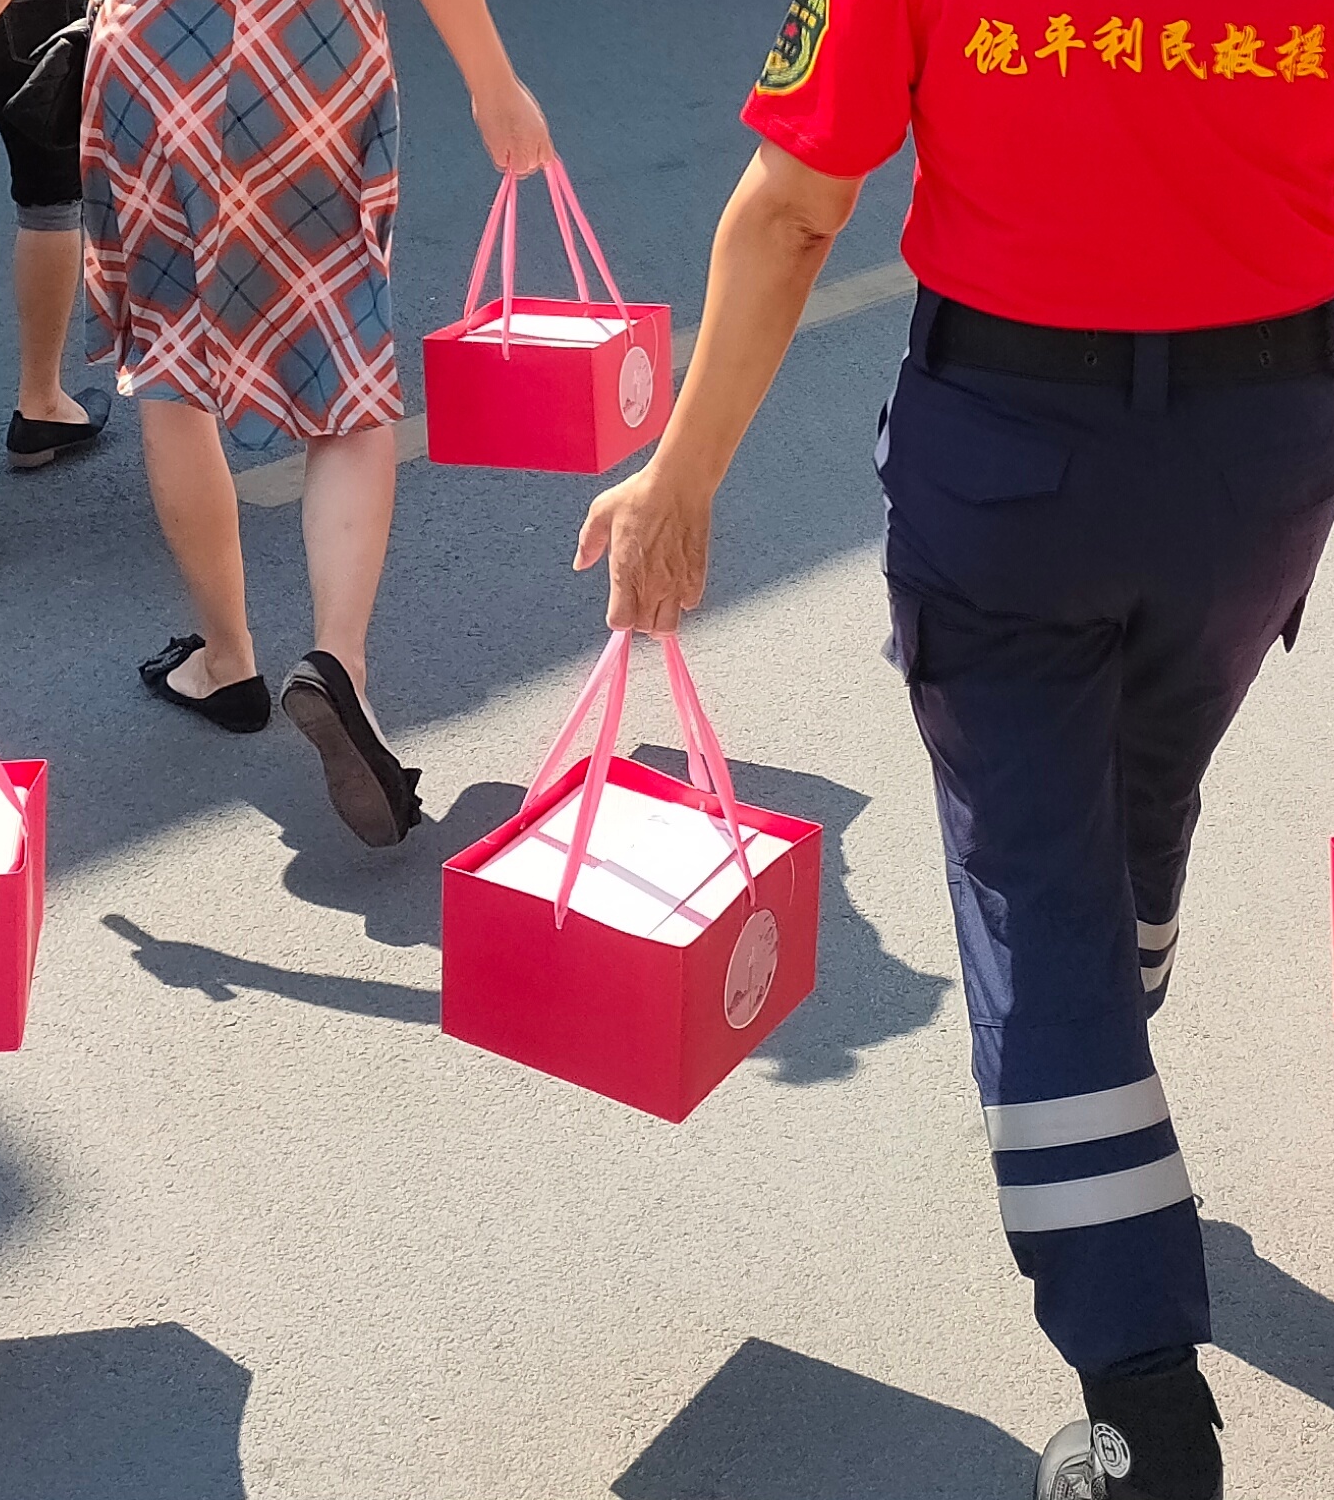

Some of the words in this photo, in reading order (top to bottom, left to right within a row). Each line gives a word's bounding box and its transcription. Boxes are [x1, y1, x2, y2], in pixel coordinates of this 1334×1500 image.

[964, 14, 1329, 83] 饶平利民救援
